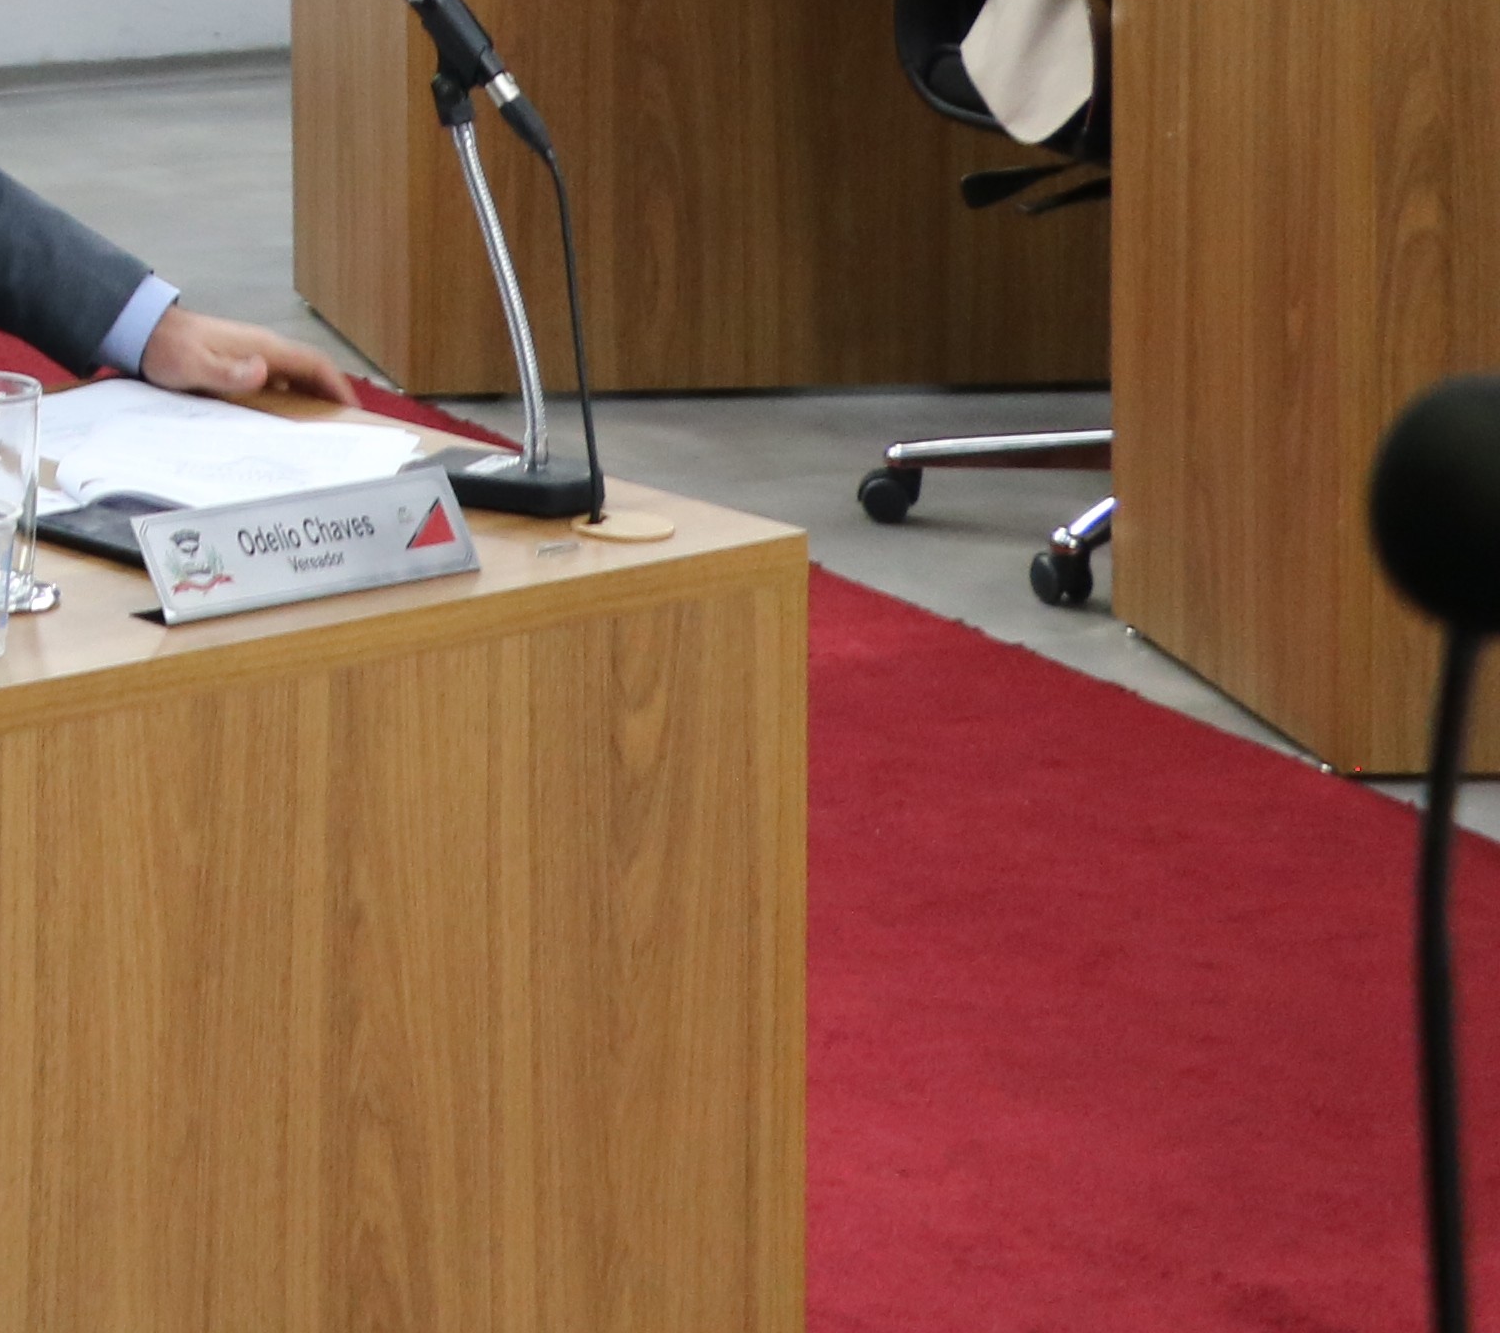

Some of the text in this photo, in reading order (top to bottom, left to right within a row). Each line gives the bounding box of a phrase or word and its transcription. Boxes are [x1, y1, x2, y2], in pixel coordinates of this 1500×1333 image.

[237, 508, 376, 559] Odelio Chaves
[286, 547, 347, 574] Vereador
